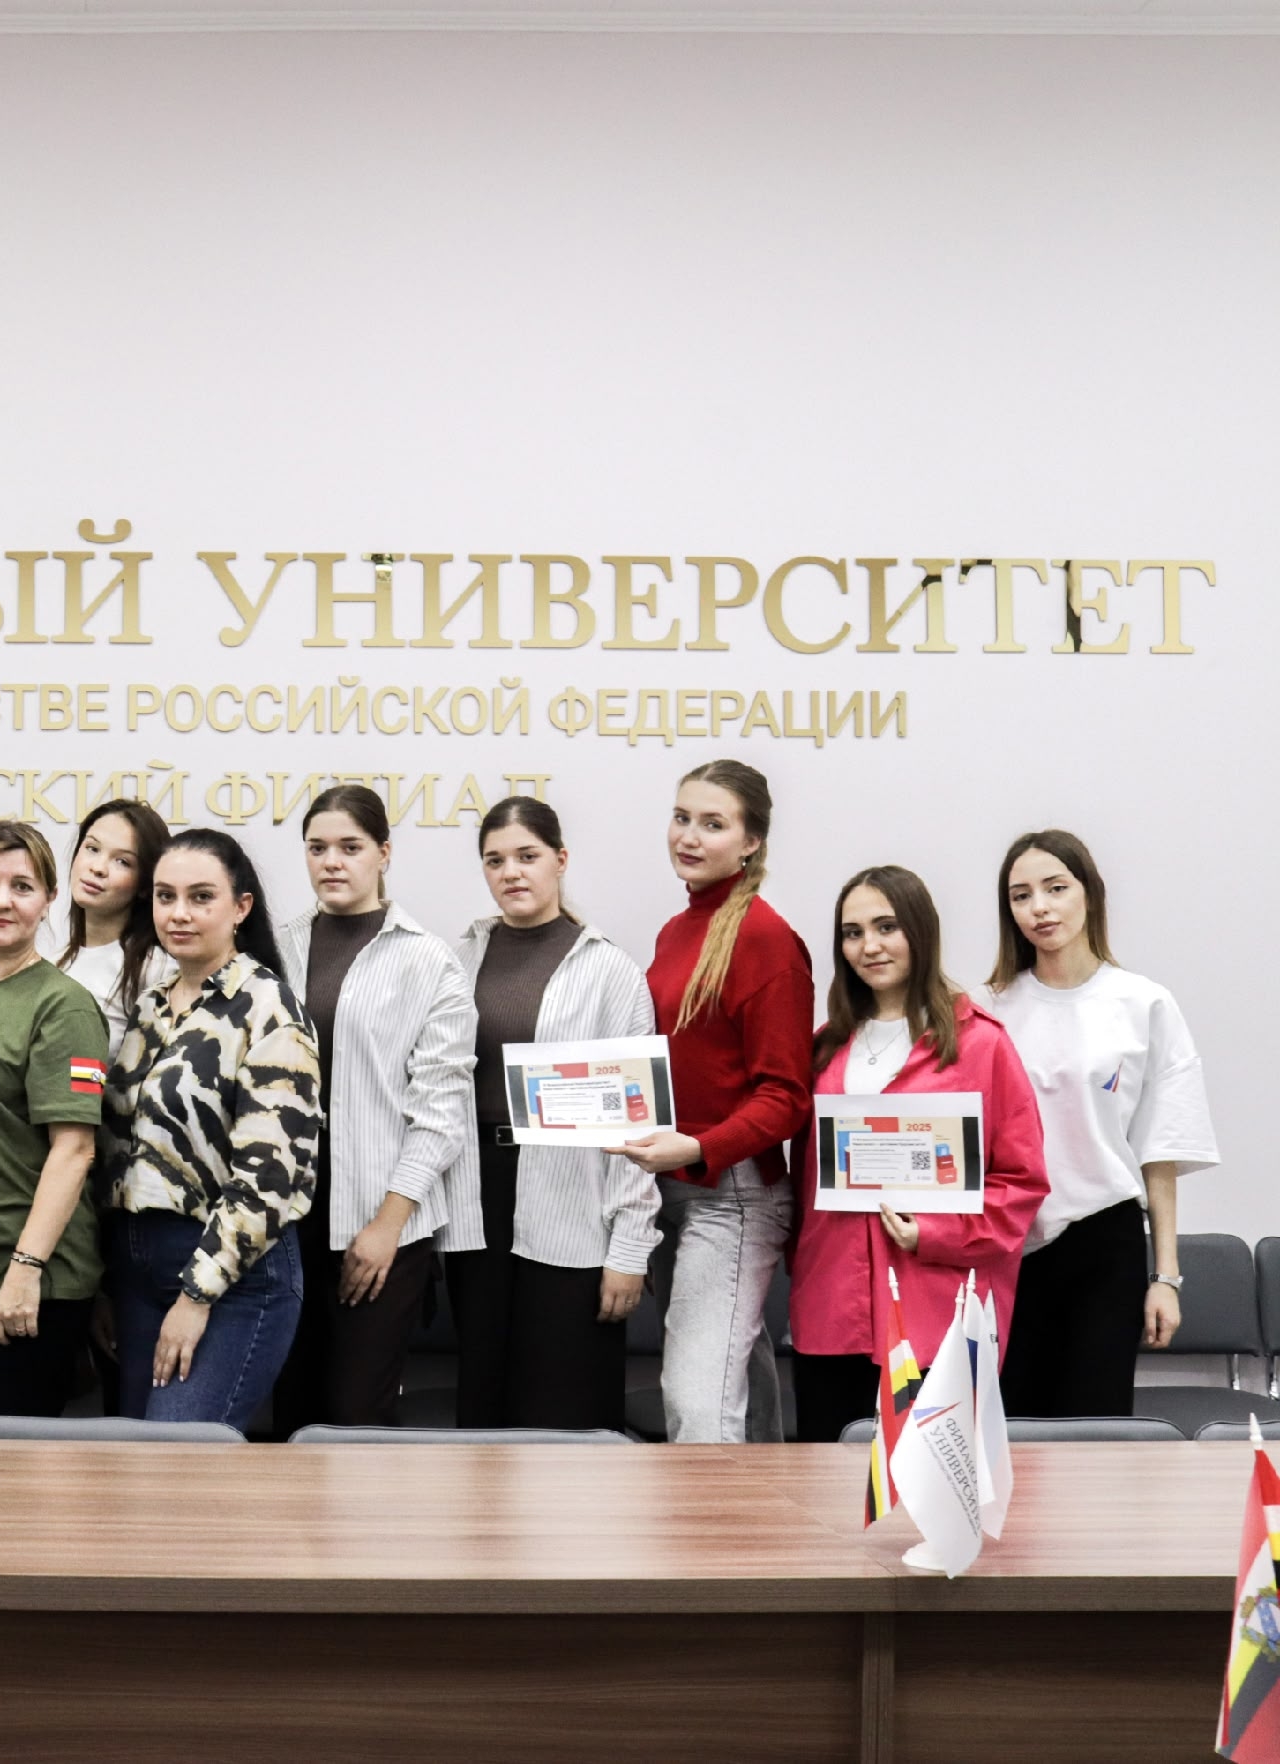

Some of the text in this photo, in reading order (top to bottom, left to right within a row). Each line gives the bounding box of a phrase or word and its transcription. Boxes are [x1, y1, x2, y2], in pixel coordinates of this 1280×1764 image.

[196, 551, 1217, 655] УНИВЕРСИТЕТ
[126, 675, 530, 735] РОССИЙСКОЙ
[547, 685, 908, 748] ФЕДЕРАЦИИ
[595, 1065, 621, 1075] 2025
[906, 1123, 932, 1132] 2025
